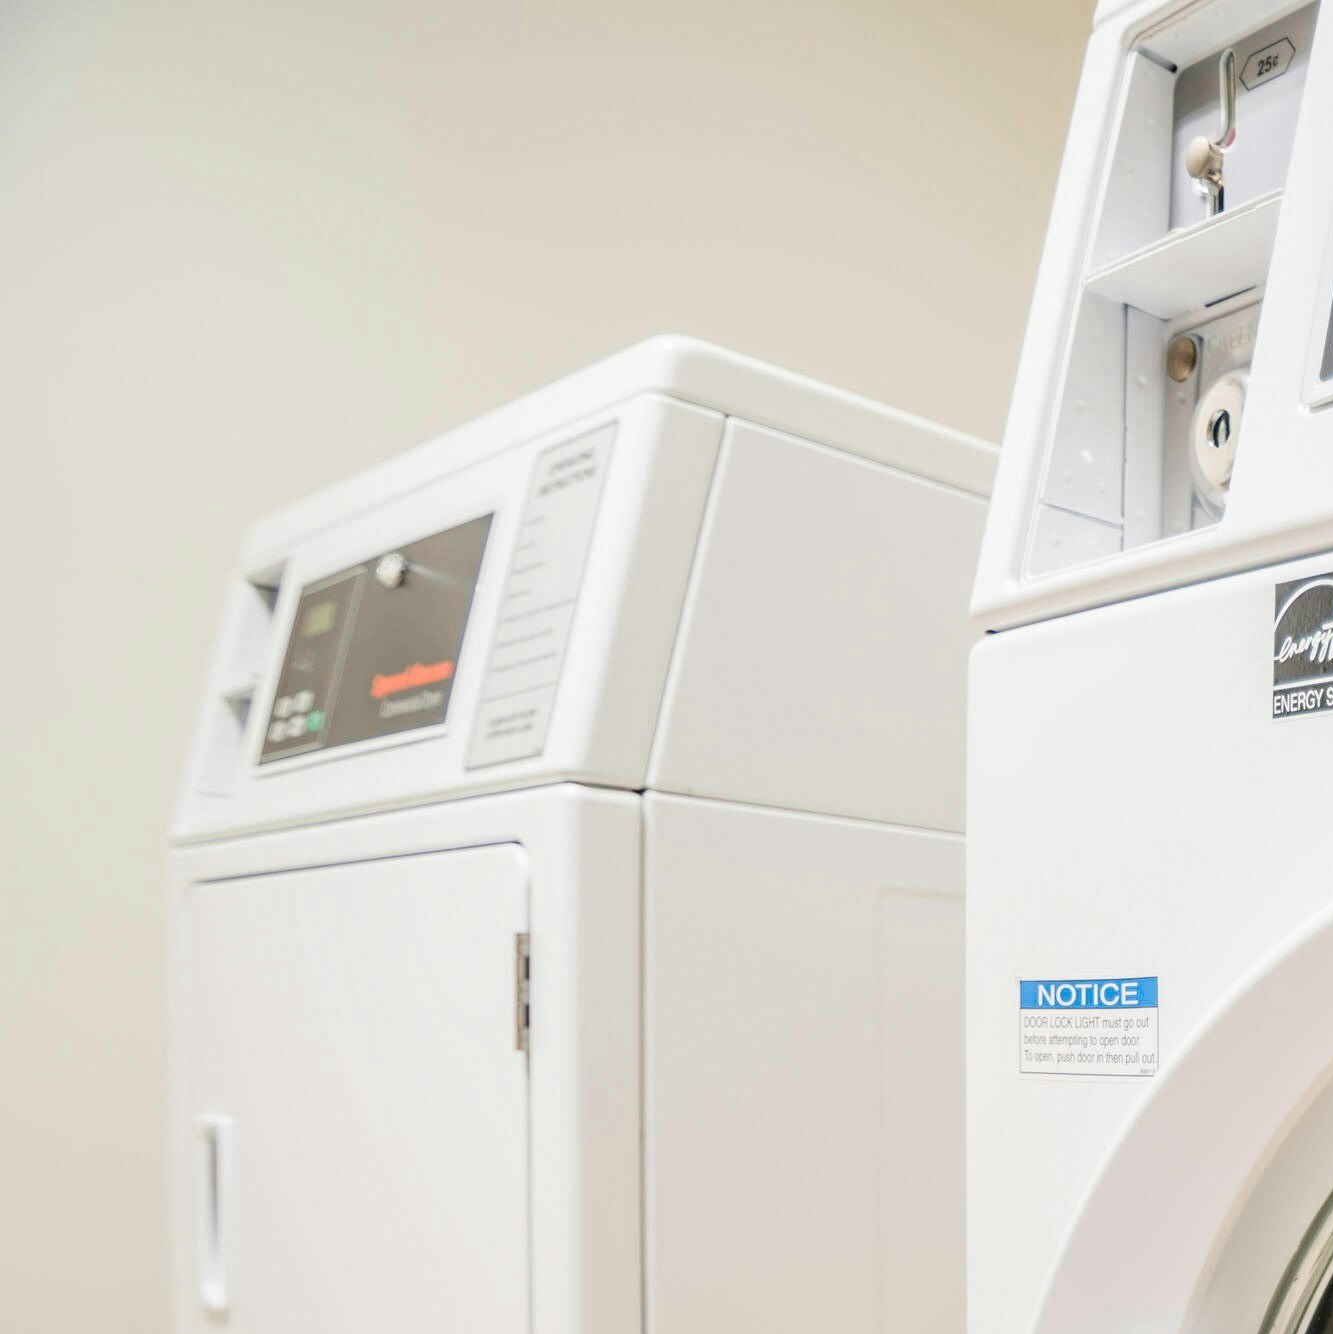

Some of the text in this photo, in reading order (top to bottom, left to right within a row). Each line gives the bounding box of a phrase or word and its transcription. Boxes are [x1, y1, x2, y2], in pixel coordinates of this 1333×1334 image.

[1273, 687, 1325, 715] ENERGY
[1037, 982, 1139, 1006] NOTICE
[1024, 1016, 1149, 1031] DOOR LOCK LIGHT must go out
[1024, 1034, 1047, 1045] before
[1049, 1035, 1088, 1047] attempting
[1089, 1035, 1098, 1046] to
[1100, 1036, 1119, 1047] open
[1024, 1050, 1033, 1061] To
[1057, 1051, 1076, 1064] push
[1077, 1051, 1095, 1063] door
[1096, 1051, 1104, 1063] in
[1106, 1052, 1124, 1063] then
[1125, 1052, 1140, 1066] pull
